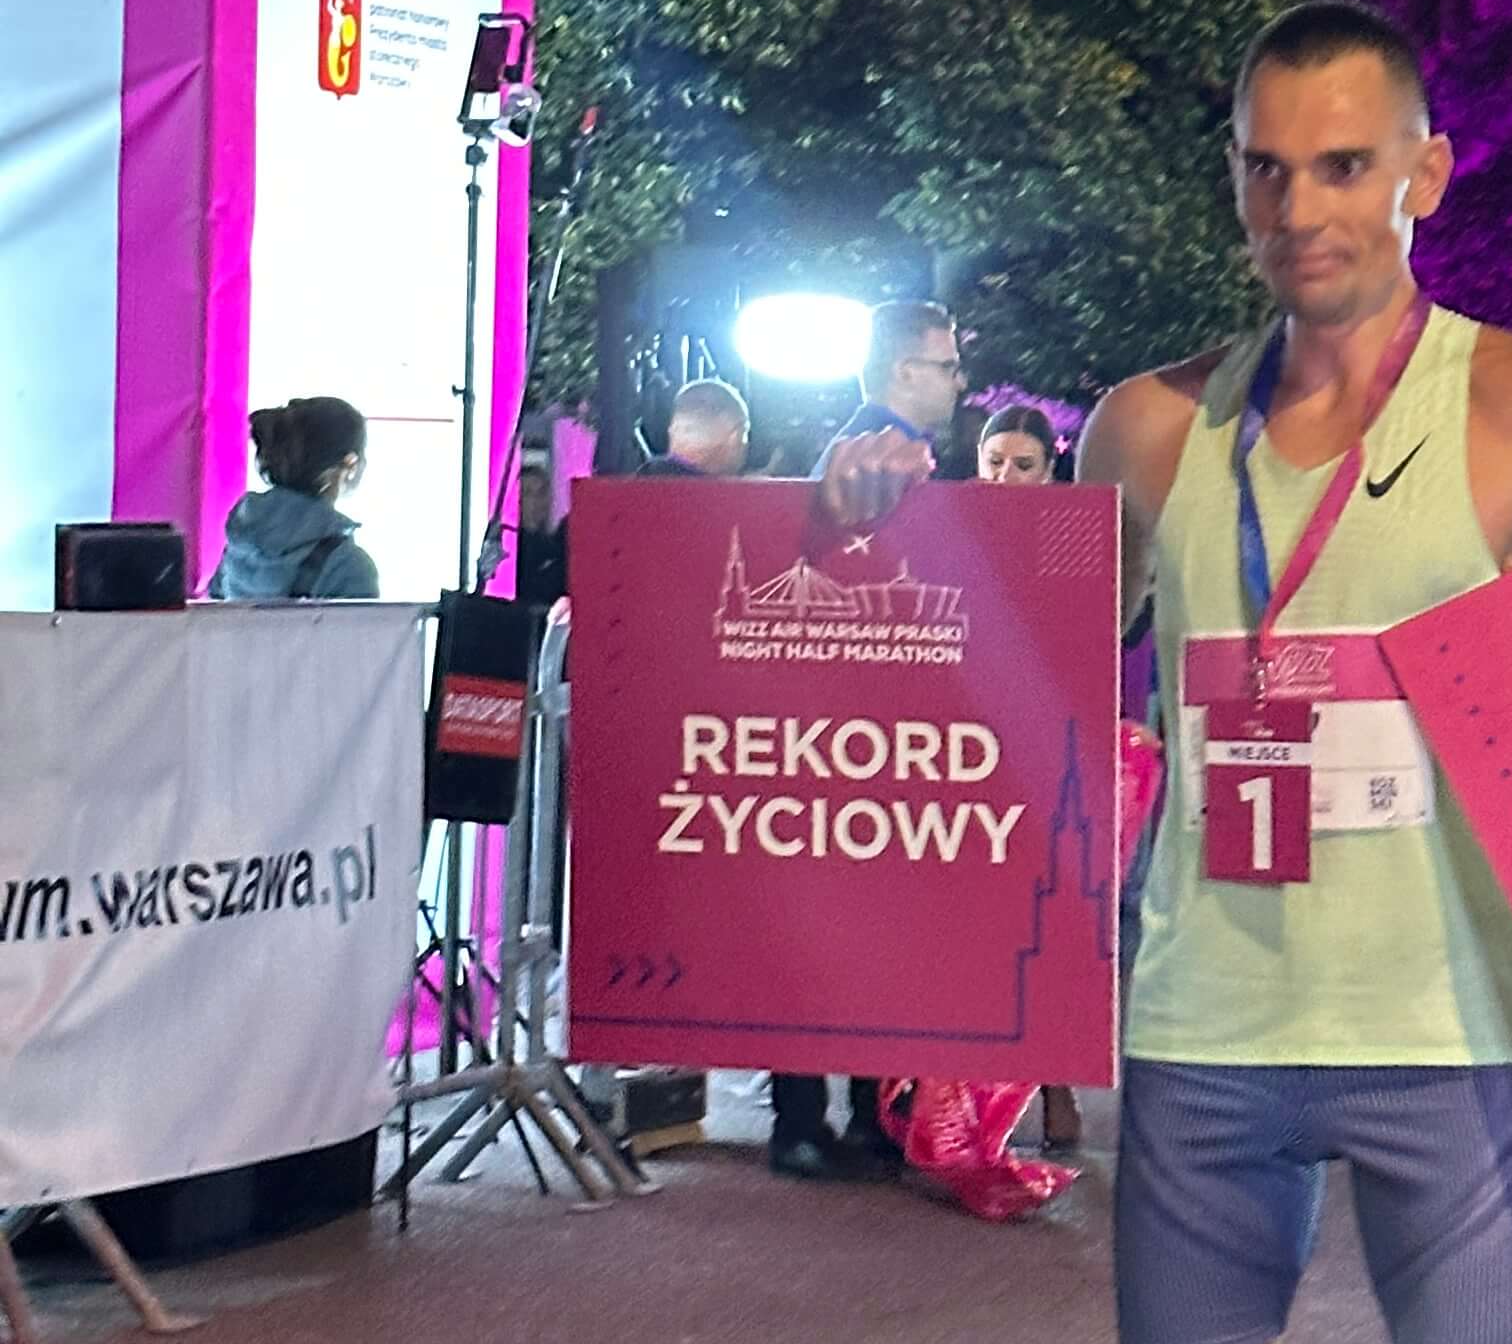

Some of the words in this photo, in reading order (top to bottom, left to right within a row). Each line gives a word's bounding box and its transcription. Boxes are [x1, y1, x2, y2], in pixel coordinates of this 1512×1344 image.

[720, 639, 785, 660] NIGHT
[785, 641, 841, 661] HALF
[843, 643, 962, 664] MARATHON
[722, 619, 769, 638] WIZZ
[771, 620, 803, 639] AIR
[806, 622, 891, 641] WARSAW
[894, 623, 962, 642] PRASKI
[682, 714, 1000, 782] REKORD
[658, 778, 1027, 864] ŻYCIOWY
[1237, 777, 1272, 871] 1
